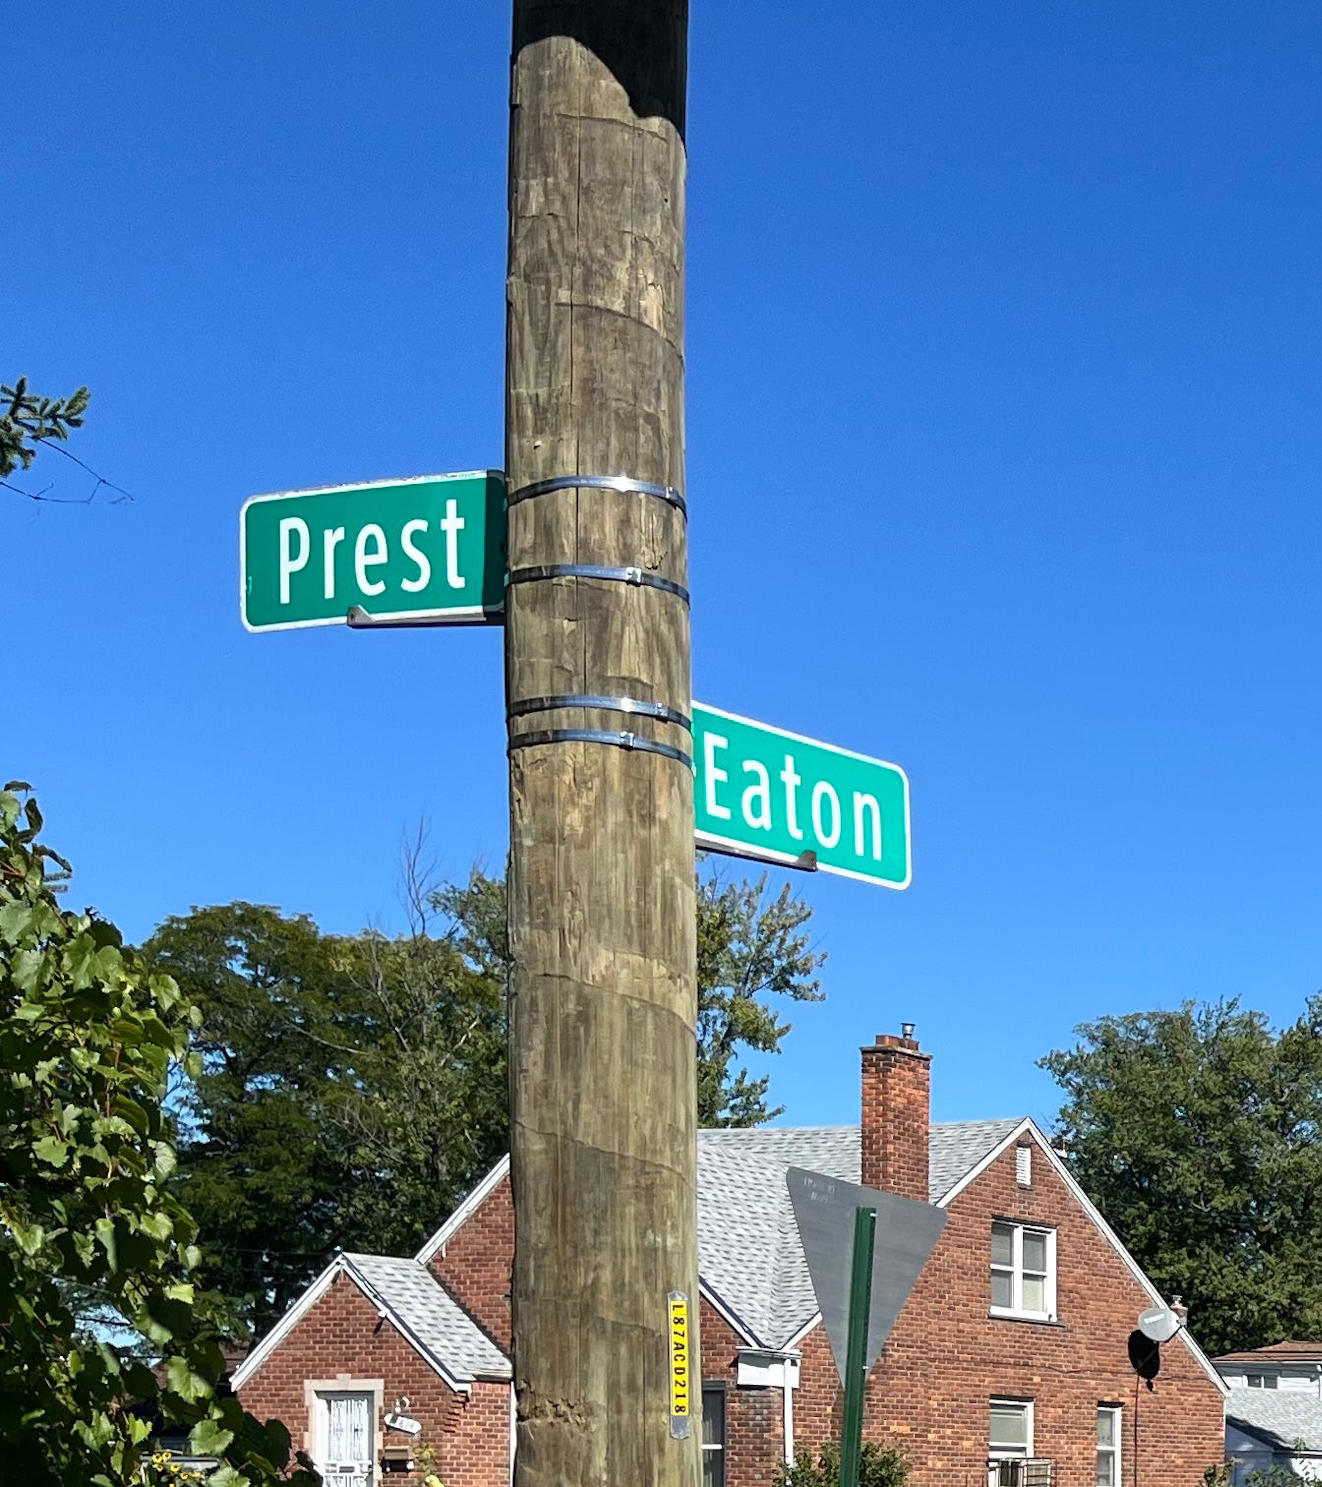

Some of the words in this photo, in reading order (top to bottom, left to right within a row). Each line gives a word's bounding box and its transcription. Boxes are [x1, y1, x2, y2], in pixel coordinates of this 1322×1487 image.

[278, 498, 466, 605] Prest
[703, 732, 882, 861] Eaton
[672, 1304, 687, 1414] L87ACD218
